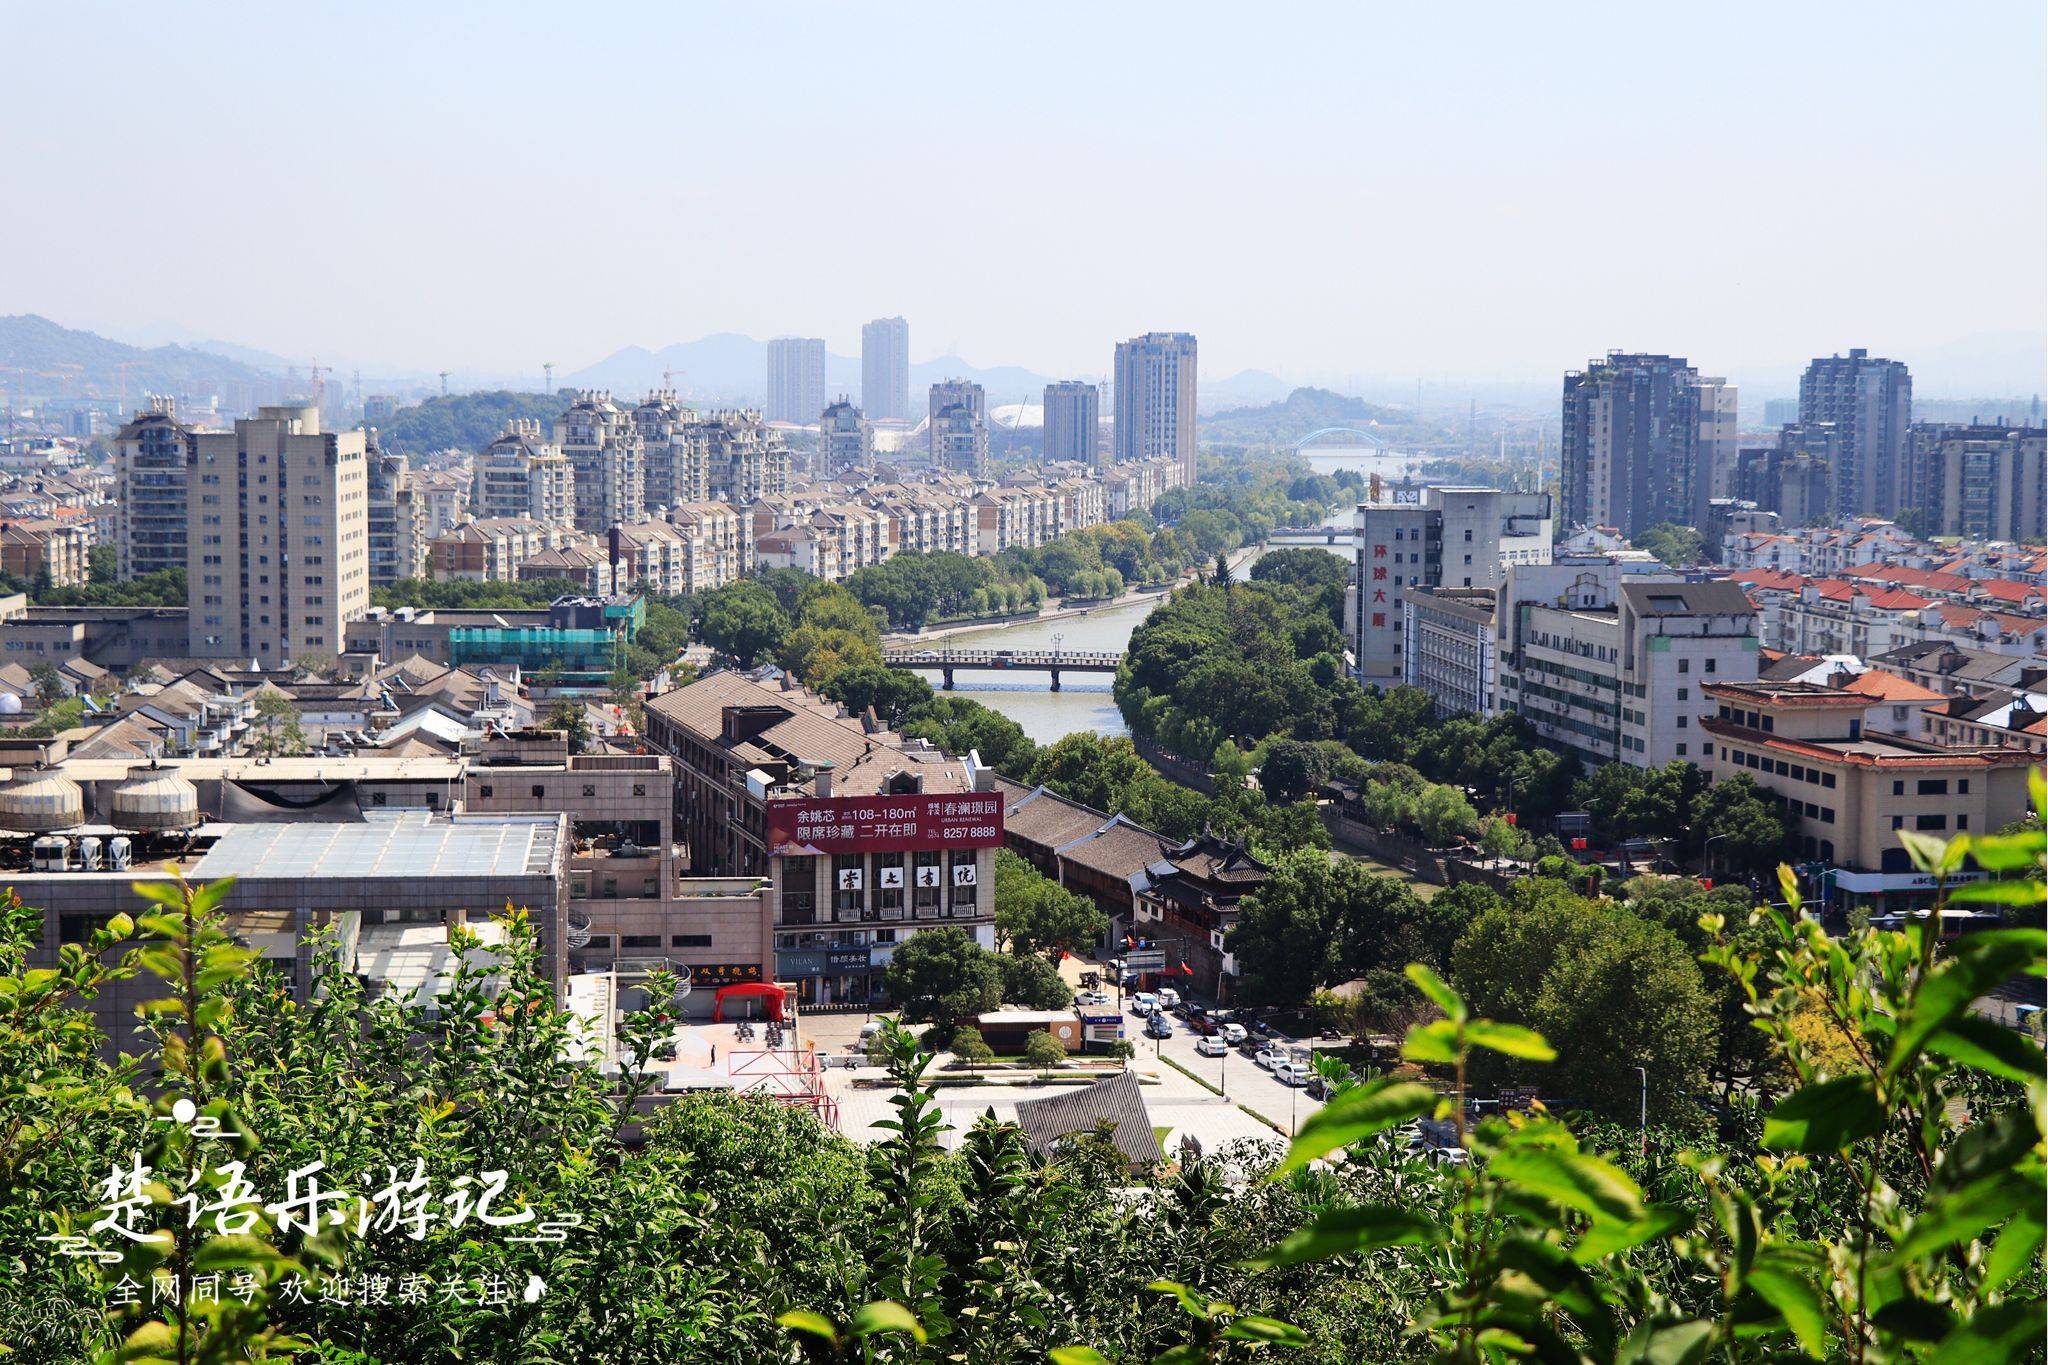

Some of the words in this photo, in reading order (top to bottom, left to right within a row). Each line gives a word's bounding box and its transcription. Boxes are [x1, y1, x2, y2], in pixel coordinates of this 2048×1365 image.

[944, 801, 997, 816] 春澜璟园
[797, 809, 835, 823] 余姚芯
[797, 825, 855, 841] 限席珍藏
[859, 823, 917, 838] 二开在即
[943, 827, 968, 839] 8257
[970, 826, 996, 838] 8888
[1912, 877, 1929, 885] ABC
